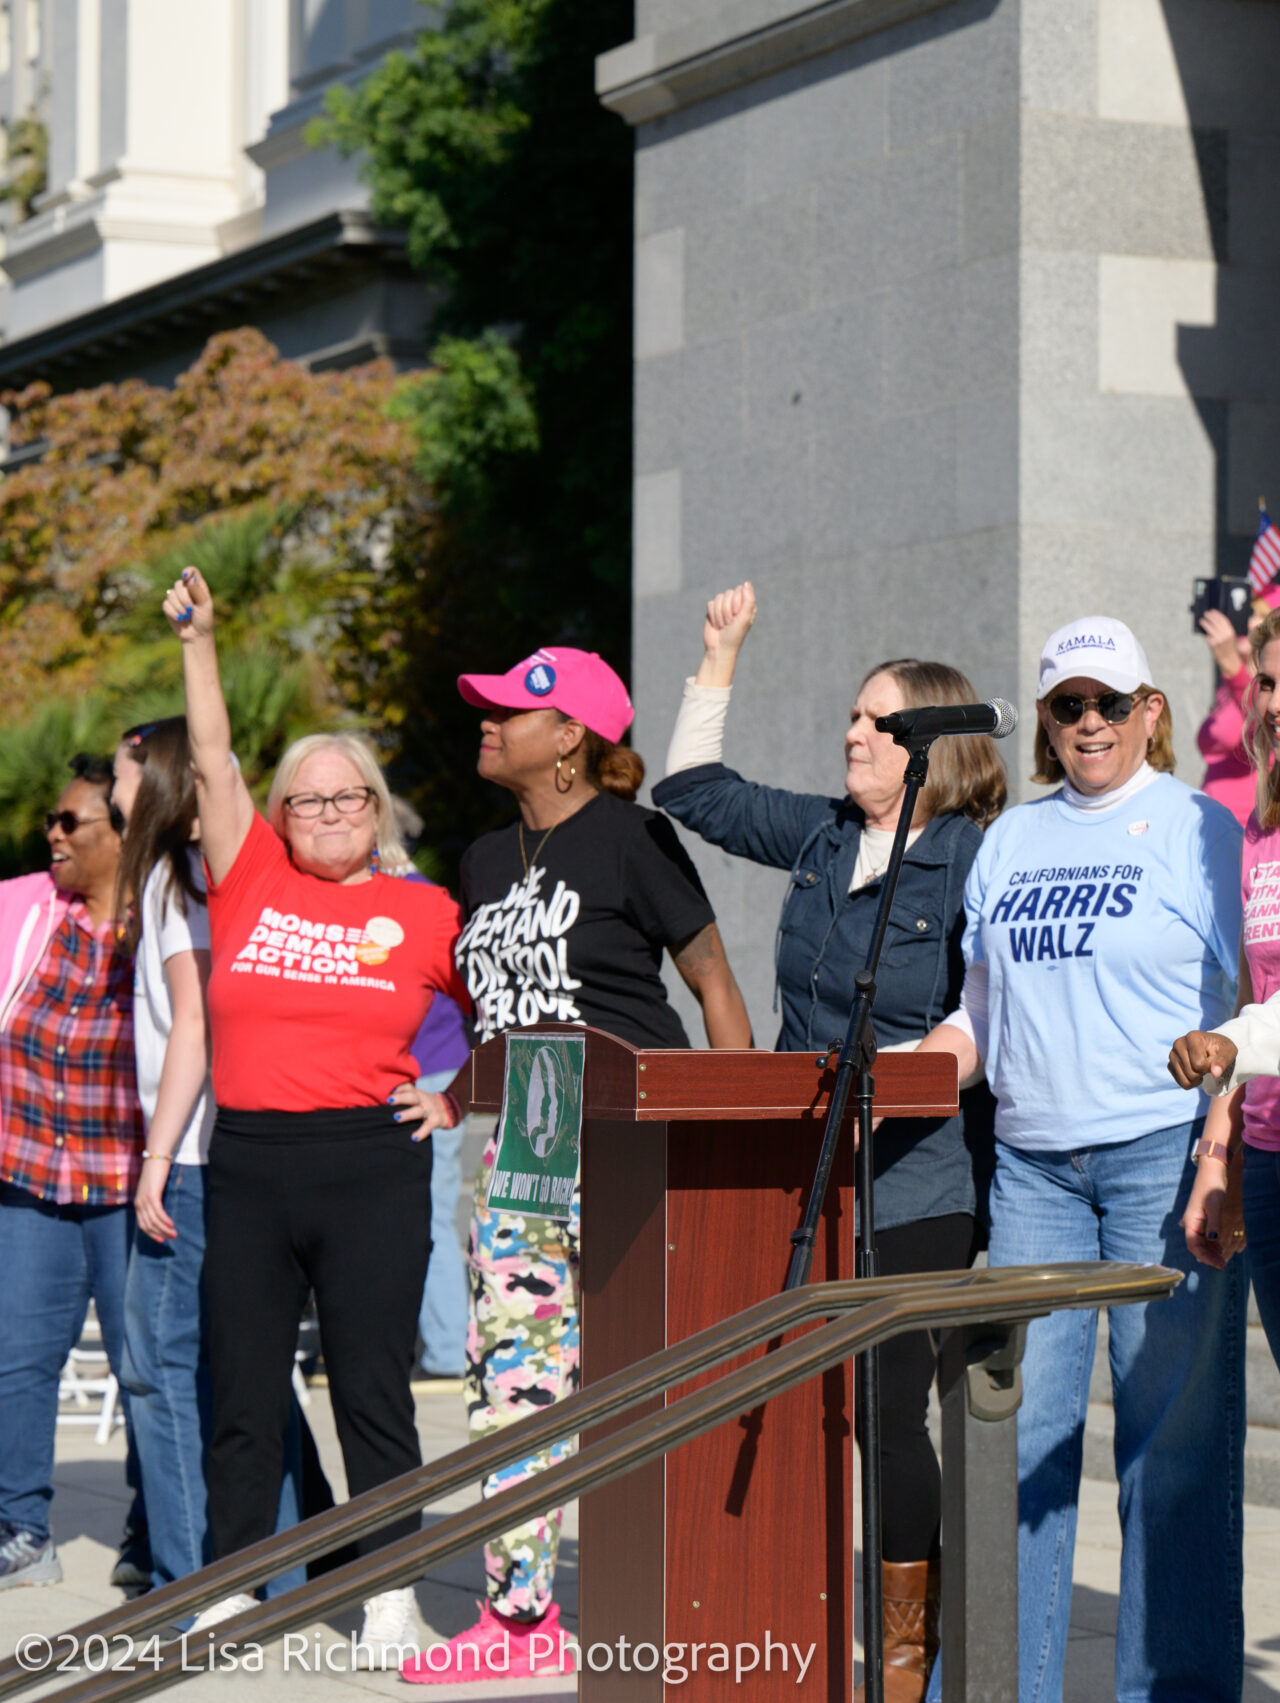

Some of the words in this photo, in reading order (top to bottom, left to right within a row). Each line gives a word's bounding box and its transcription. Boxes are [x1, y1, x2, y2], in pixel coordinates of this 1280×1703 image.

[1057, 634, 1116, 651] KAMALA
[502, 865, 547, 910] WE
[1009, 865, 1111, 886] CALIFORNIANS
[1111, 864, 1144, 881] FOR
[455, 880, 580, 956] DEMAND
[989, 883, 1138, 925] HARRIS
[259, 907, 345, 942] MOMS
[1009, 922, 1096, 963] WALZ
[236, 943, 359, 975] ACTION
[248, 925, 357, 961] DEMAN
[230, 962, 254, 974] FOR
[255, 963, 281, 978] GUN
[283, 969, 322, 984] SENSE
[324, 974, 338, 985] IN
[340, 976, 396, 992] AMERICA
[517, 988, 582, 1026] OUR
[492, 1170, 512, 1198] WE
[510, 1172, 540, 1202] WON'T
[539, 1175, 551, 1203] GO
[550, 1176, 576, 1206] BACK!
